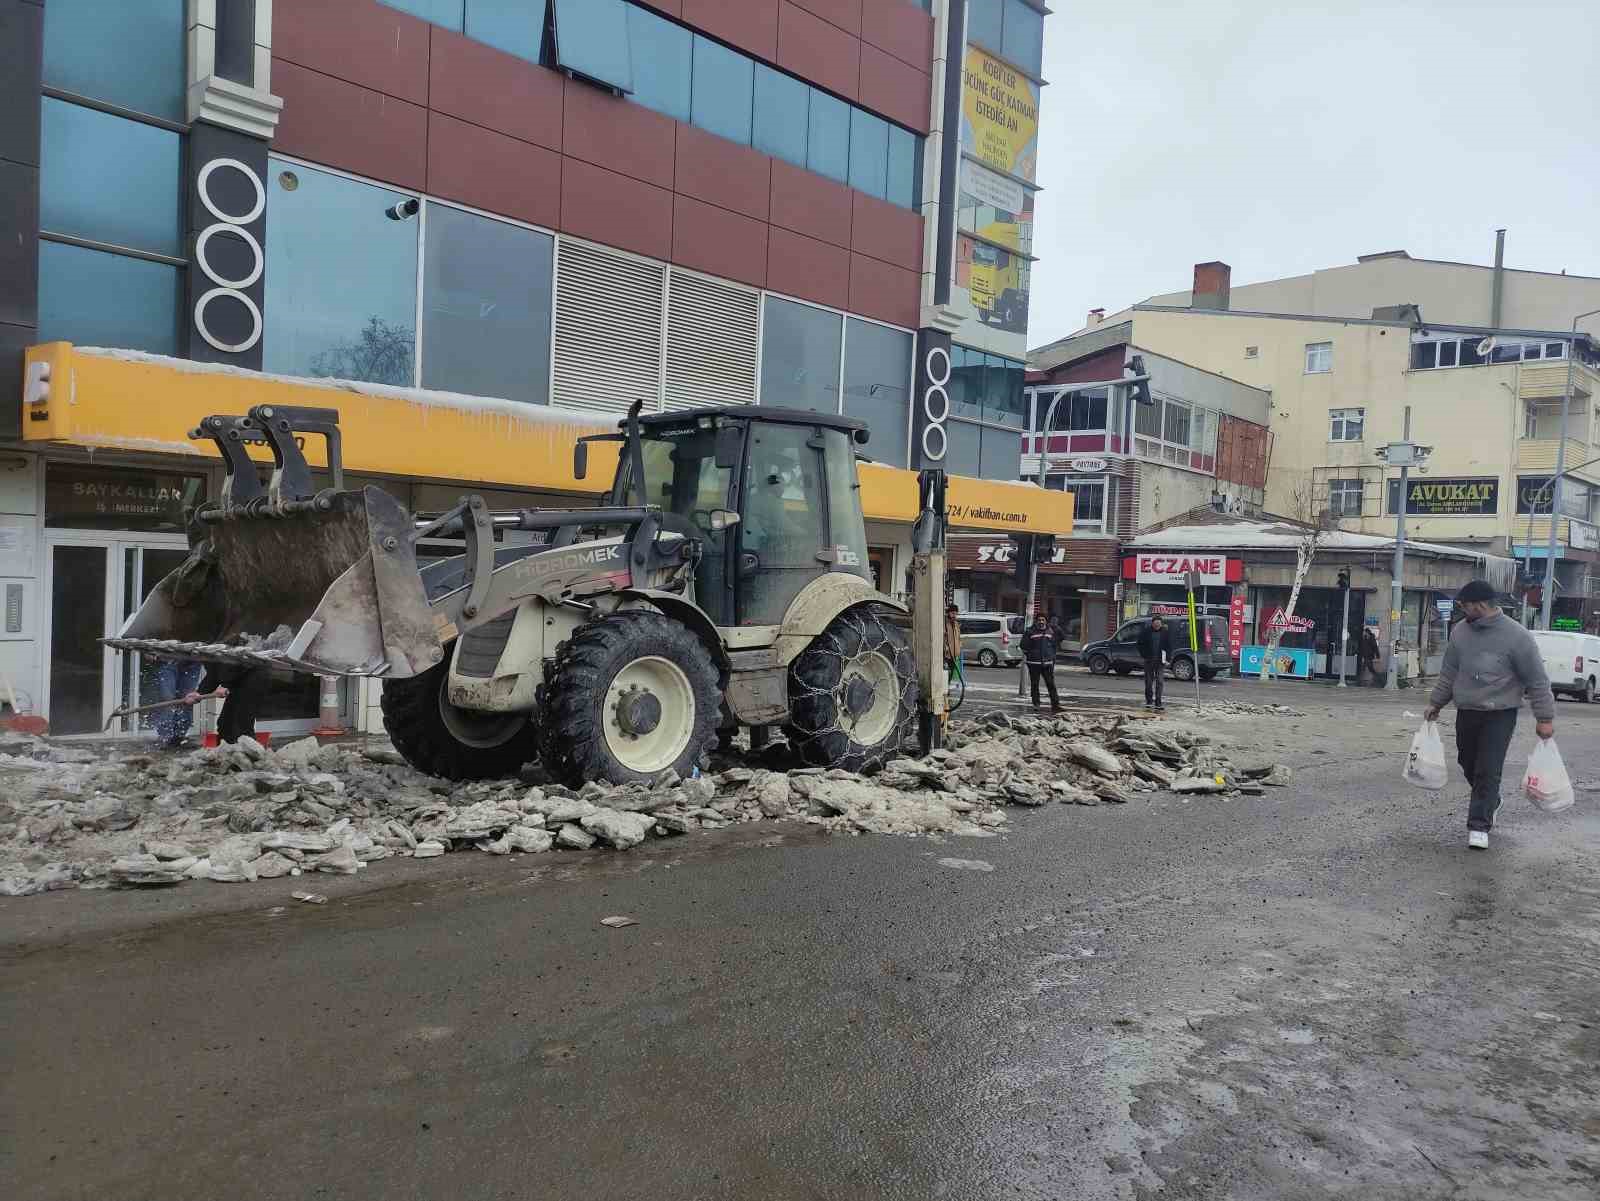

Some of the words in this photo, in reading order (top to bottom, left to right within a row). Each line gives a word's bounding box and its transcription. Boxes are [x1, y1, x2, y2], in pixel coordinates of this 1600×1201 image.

[1006, 116, 1018, 133] AN
[1409, 484, 1494, 500] AVUKAT
[1140, 557, 1221, 575] ECZANE
